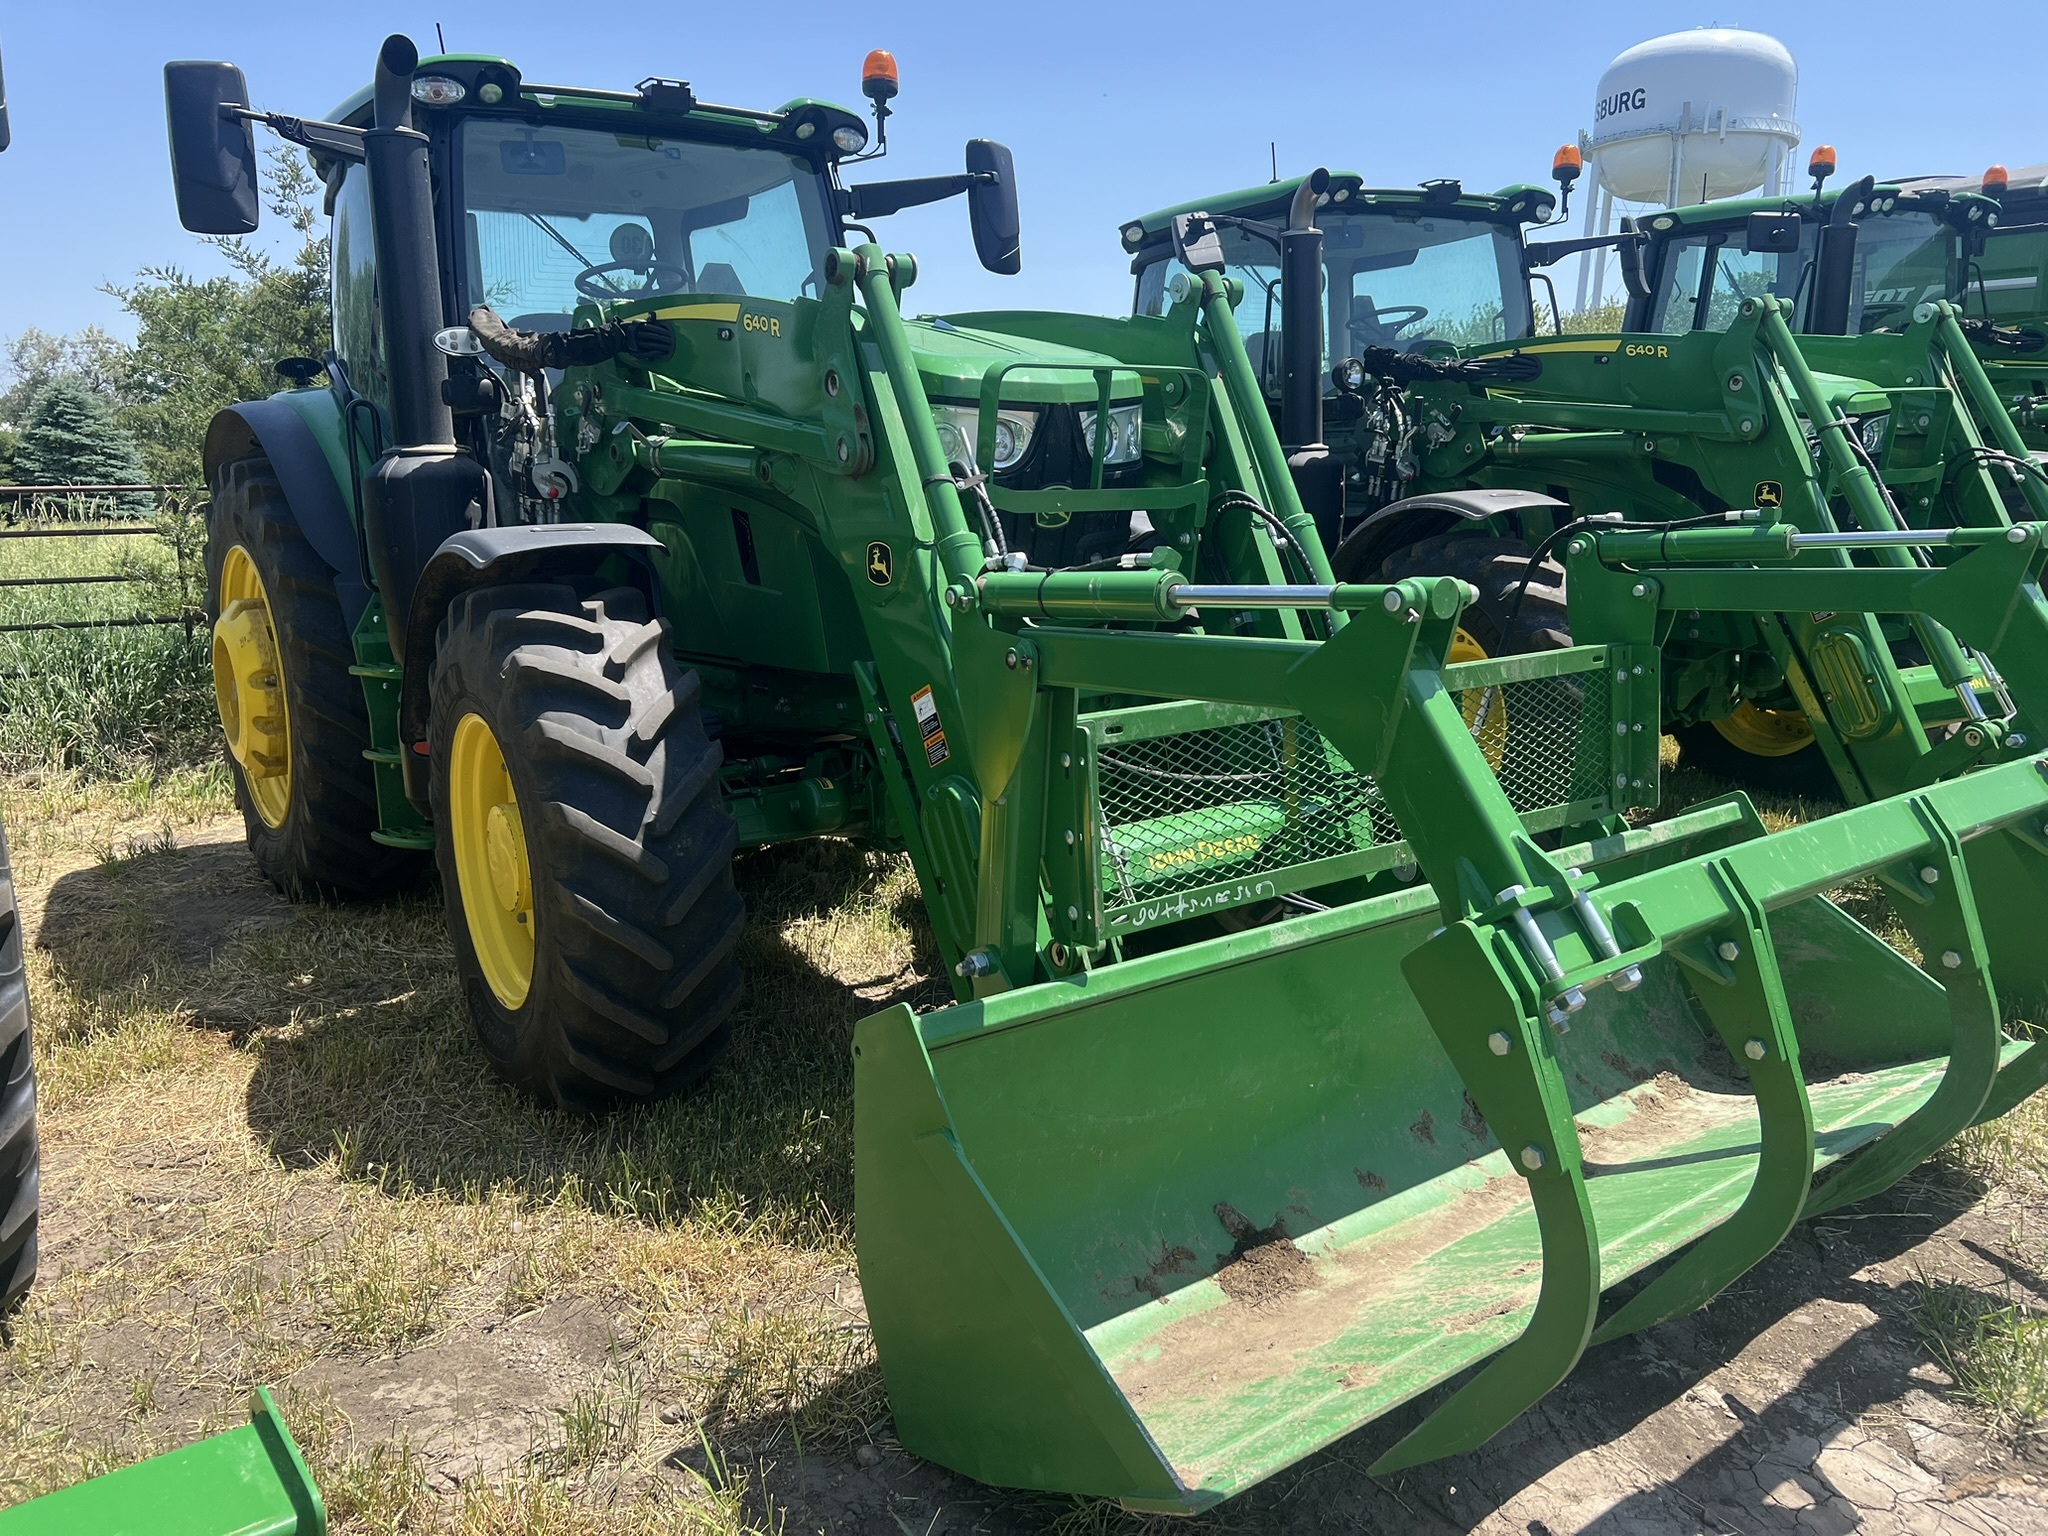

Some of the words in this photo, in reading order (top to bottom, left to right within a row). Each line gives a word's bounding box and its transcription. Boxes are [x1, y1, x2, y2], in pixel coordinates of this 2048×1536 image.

[743, 313, 769, 332] 640
[770, 317, 781, 338] R
[1625, 344, 1655, 357] 640
[1657, 345, 1668, 358] R
[1197, 834, 1261, 860] DEERE
